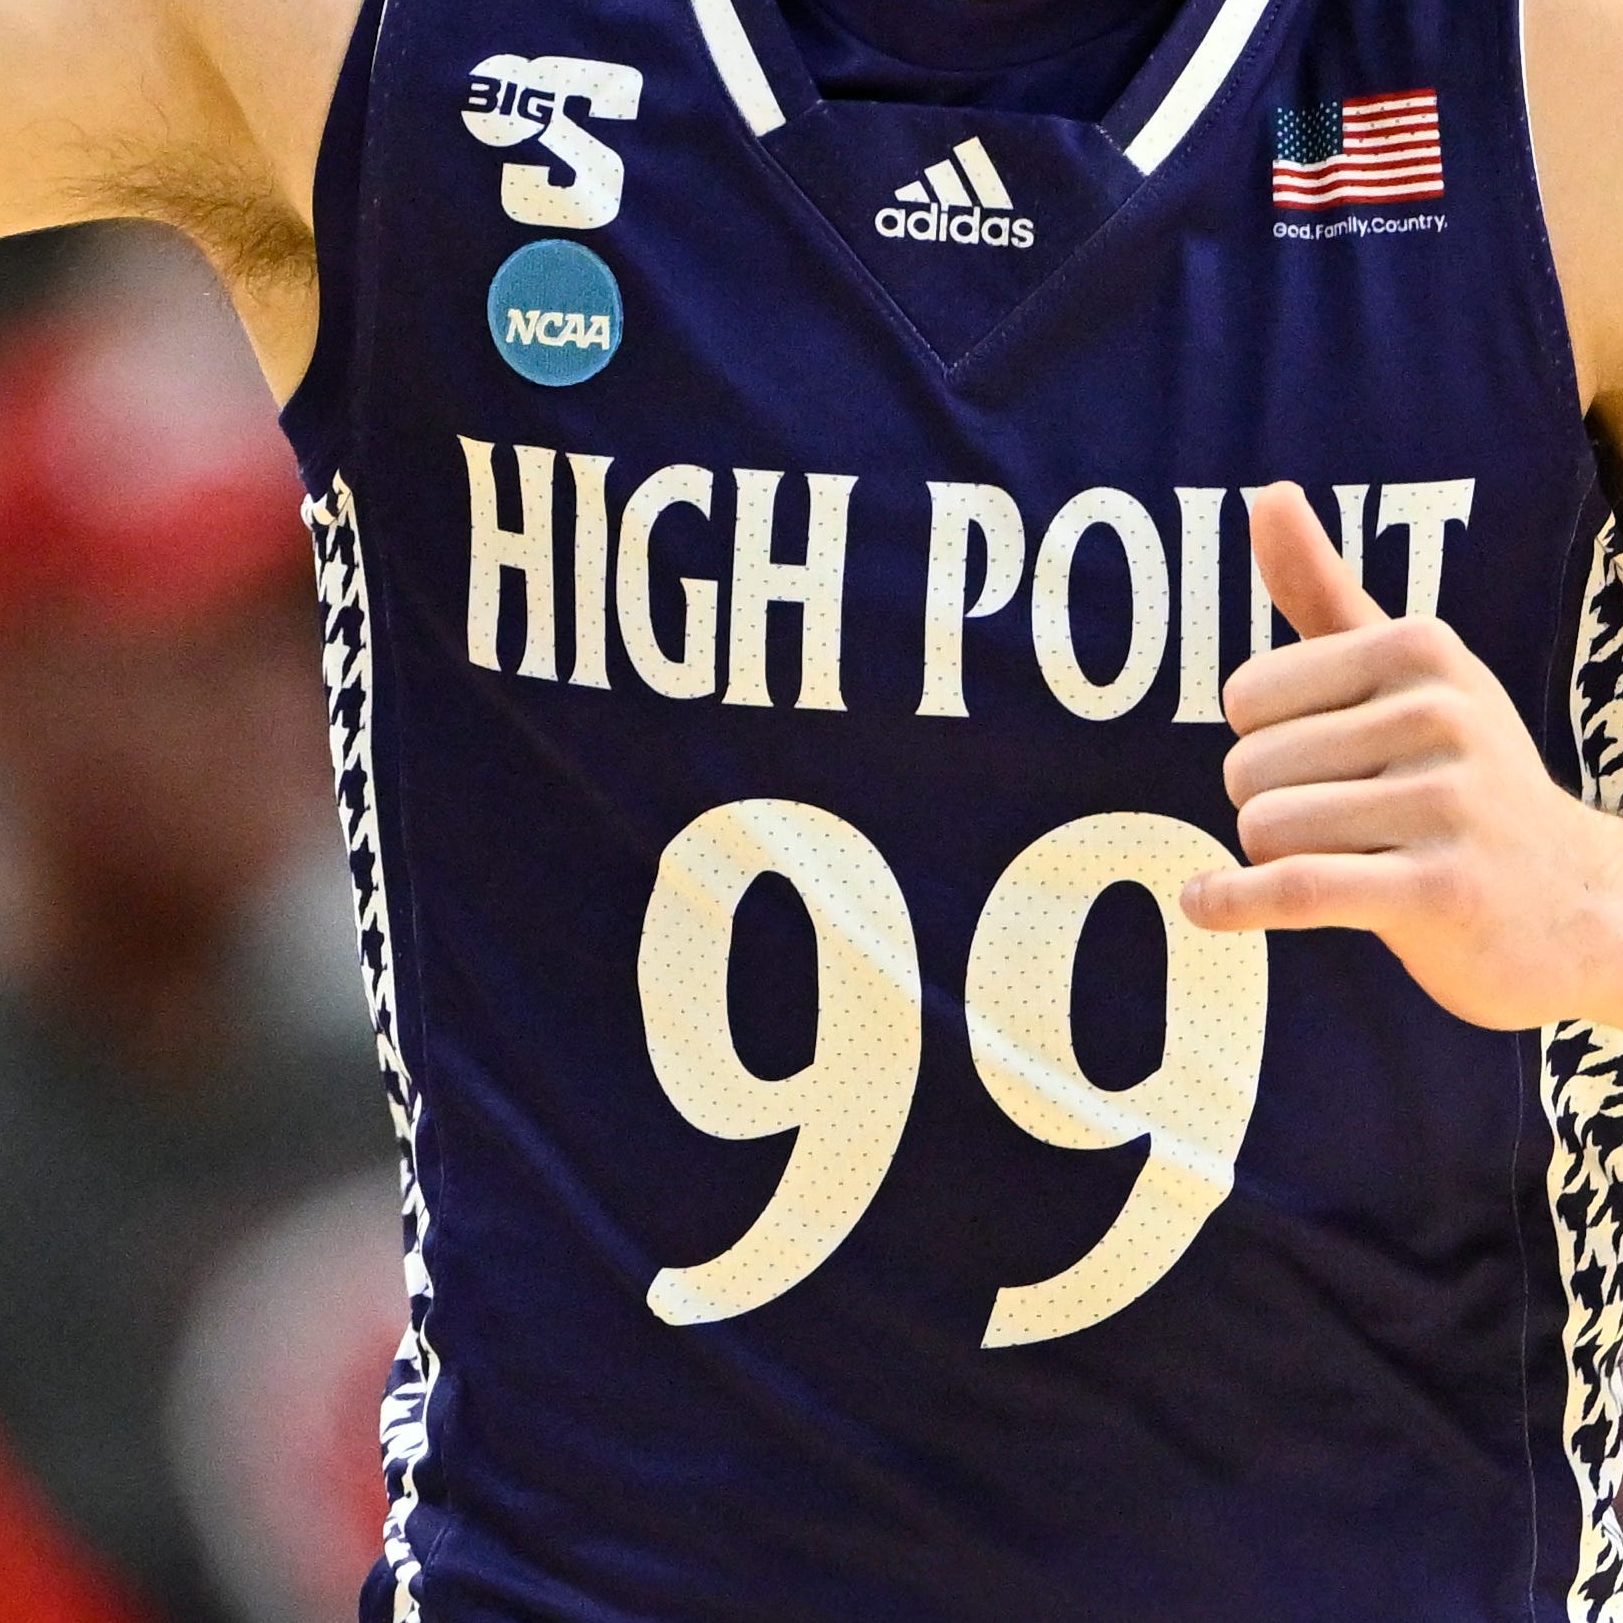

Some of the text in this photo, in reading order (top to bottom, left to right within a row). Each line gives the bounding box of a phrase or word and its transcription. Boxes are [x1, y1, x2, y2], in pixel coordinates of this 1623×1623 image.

[463, 74, 556, 126] BIG
[874, 202, 1035, 249] adidas
[504, 308, 611, 351] NCAA
[457, 434, 860, 713] HIGH
[636, 798, 1269, 1350] 99
